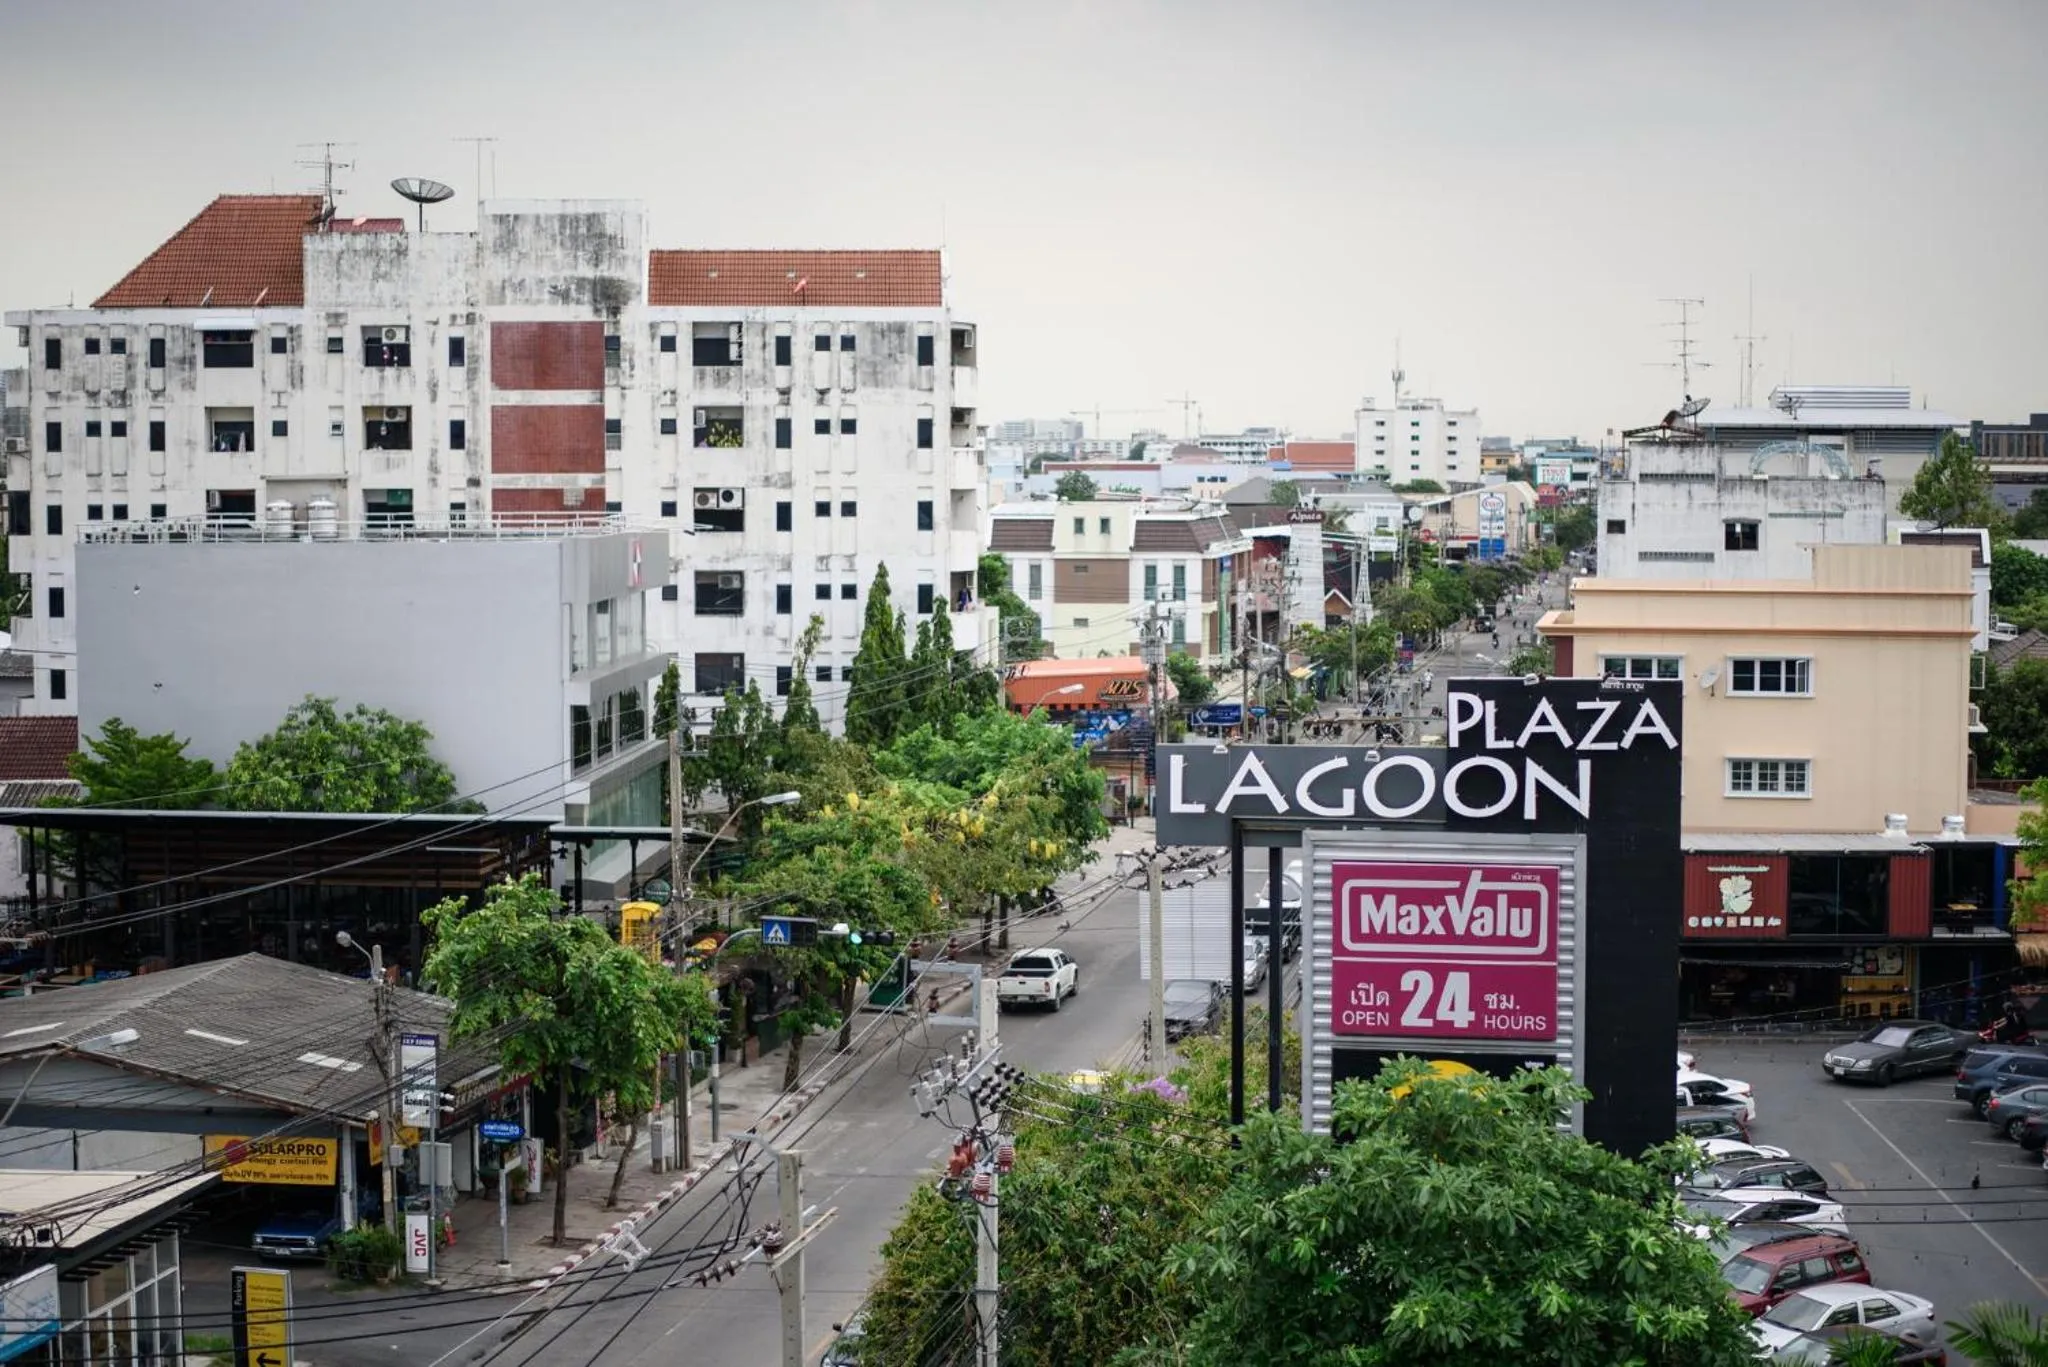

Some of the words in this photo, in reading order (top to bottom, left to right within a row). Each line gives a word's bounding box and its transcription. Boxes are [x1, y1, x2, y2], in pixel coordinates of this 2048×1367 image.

[1448, 691, 1680, 750] PLAZA
[1169, 751, 1590, 820] LAGOON
[1360, 870, 1533, 938] MaxValu
[1342, 1010, 1390, 1026] OPEN
[1484, 1014, 1547, 1031] HOURS
[1350, 982, 1390, 1006] เปิด
[1400, 969, 1476, 1029] 24
[1483, 993, 1521, 1011] ชม.
[249, 1143, 327, 1156] SOLARPRO
[414, 1228, 427, 1257] JVC
